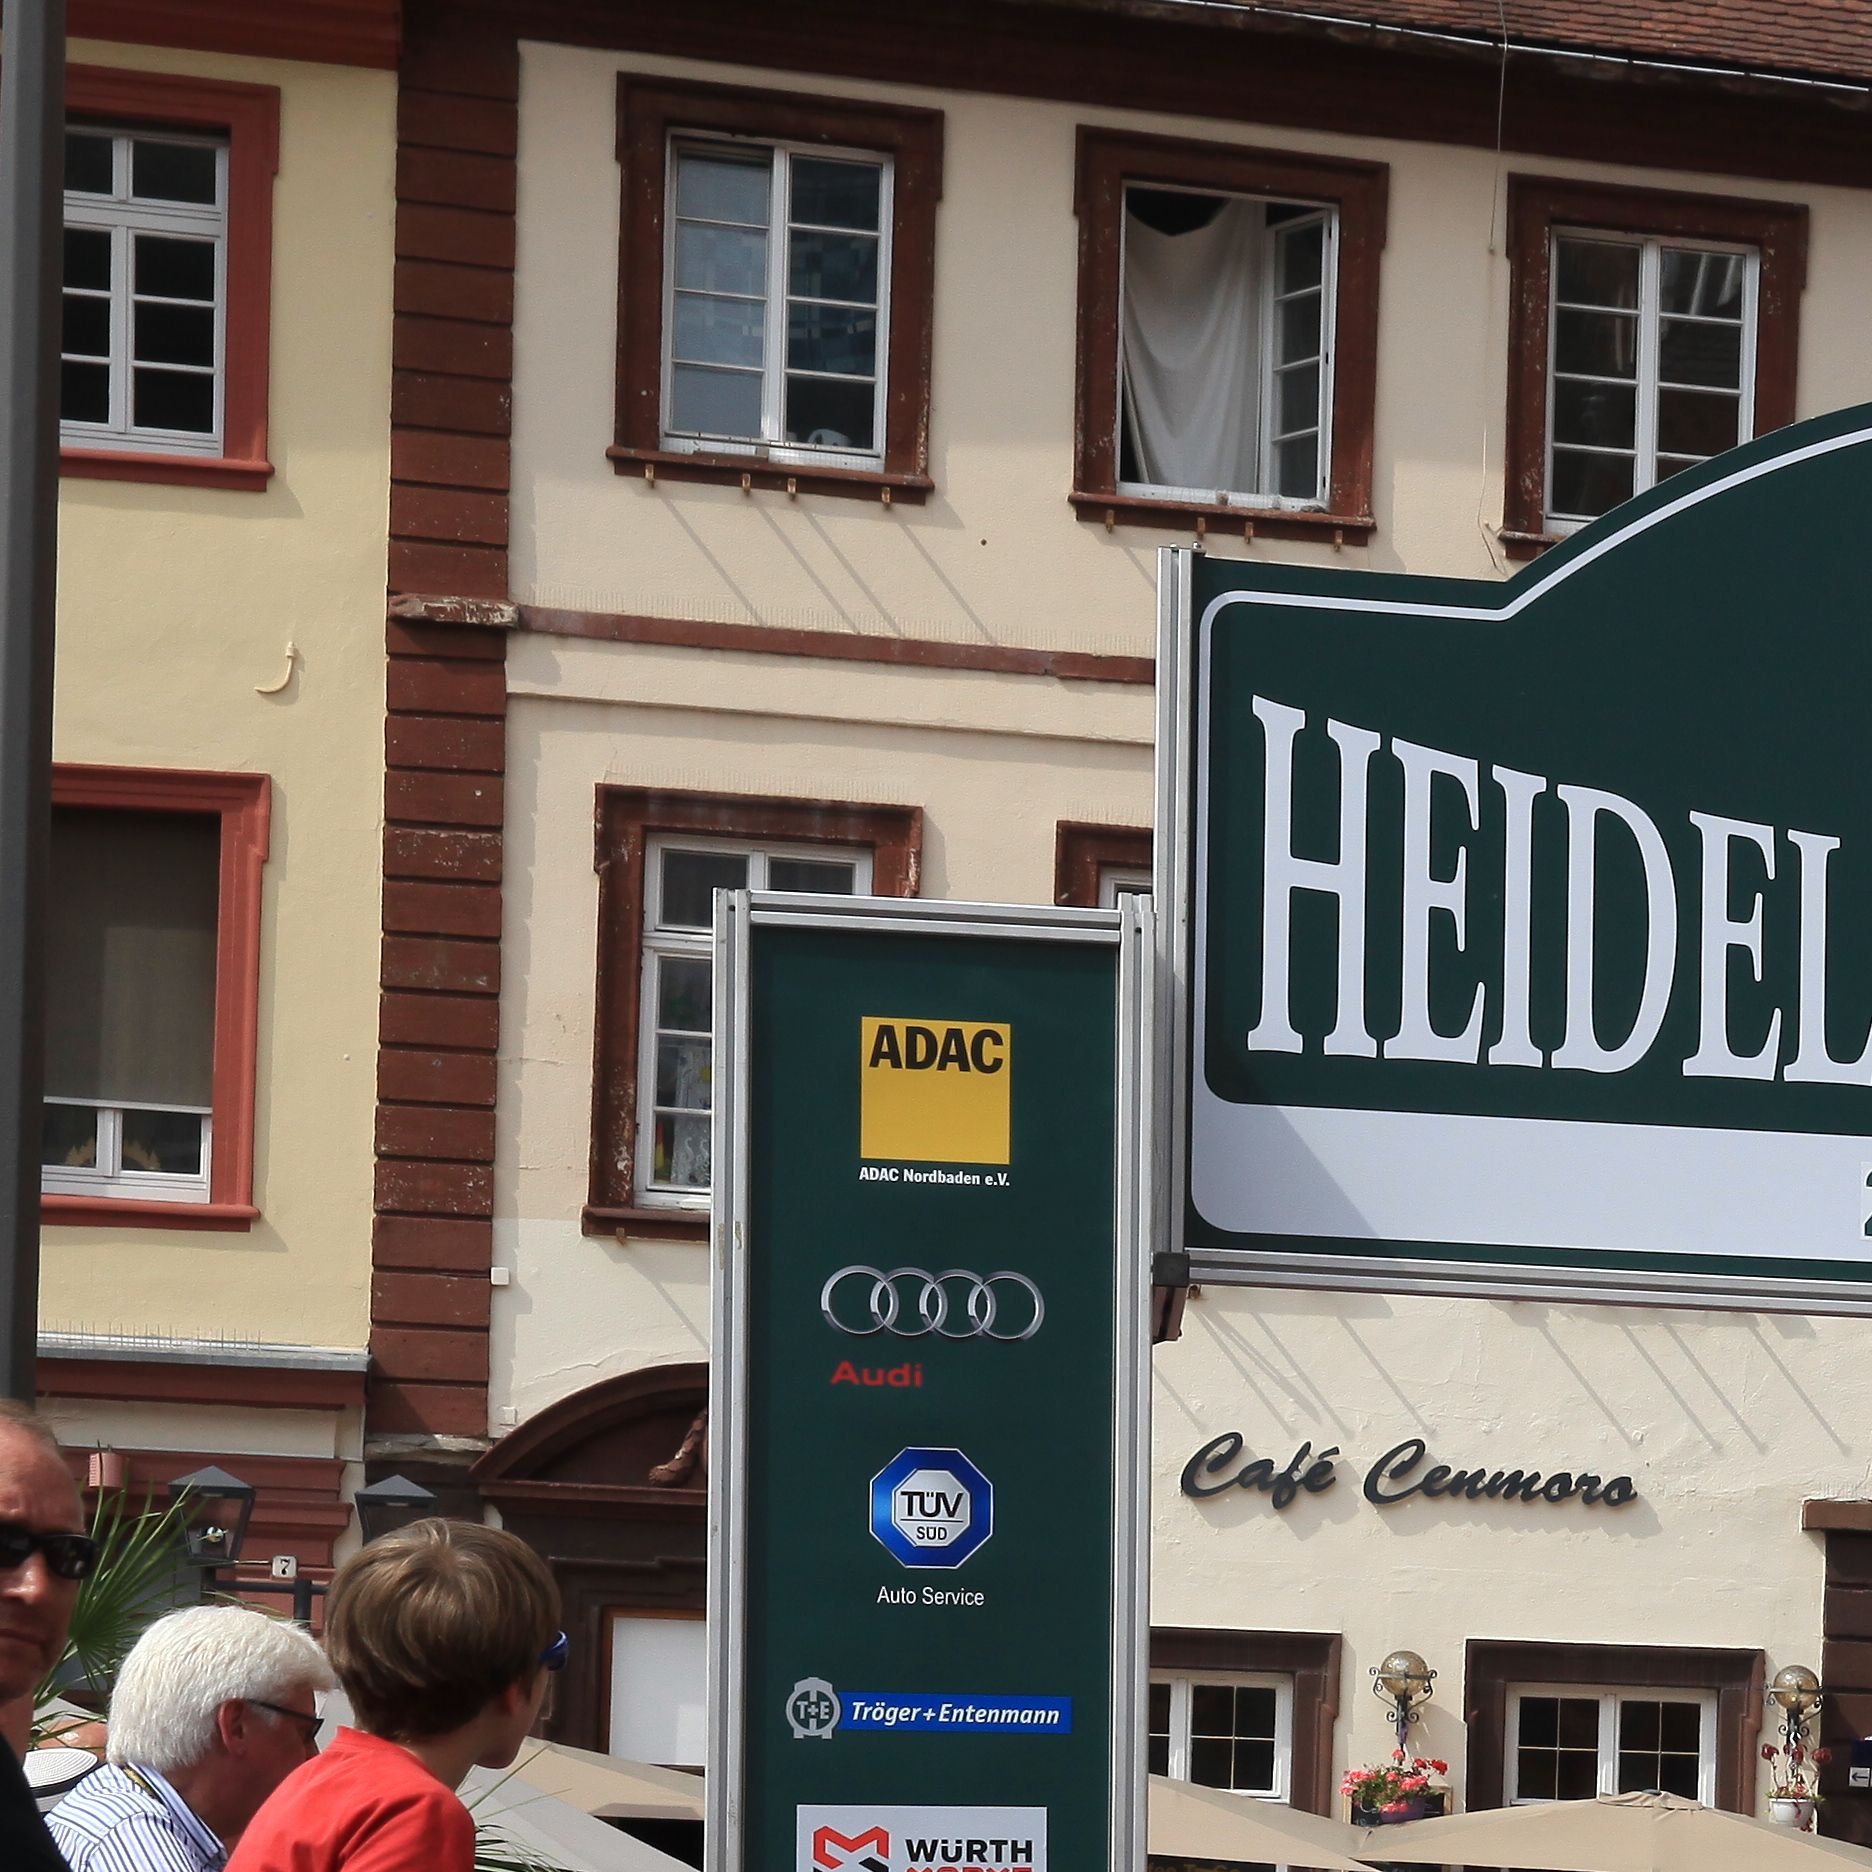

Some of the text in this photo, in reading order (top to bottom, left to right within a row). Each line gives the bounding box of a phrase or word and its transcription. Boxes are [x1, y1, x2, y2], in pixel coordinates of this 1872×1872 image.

[868, 1024, 1004, 1075] ADAC
[859, 1166, 1010, 1187] ADAC Nordbaden e.V.
[830, 1360, 924, 1388] Audi
[1180, 1431, 1340, 1510] Café
[900, 1490, 964, 1518] TÜV
[916, 1526, 948, 1541] SÜD
[877, 1586, 985, 1606] Auto Service
[905, 1838, 1033, 1864] WÜRTH
